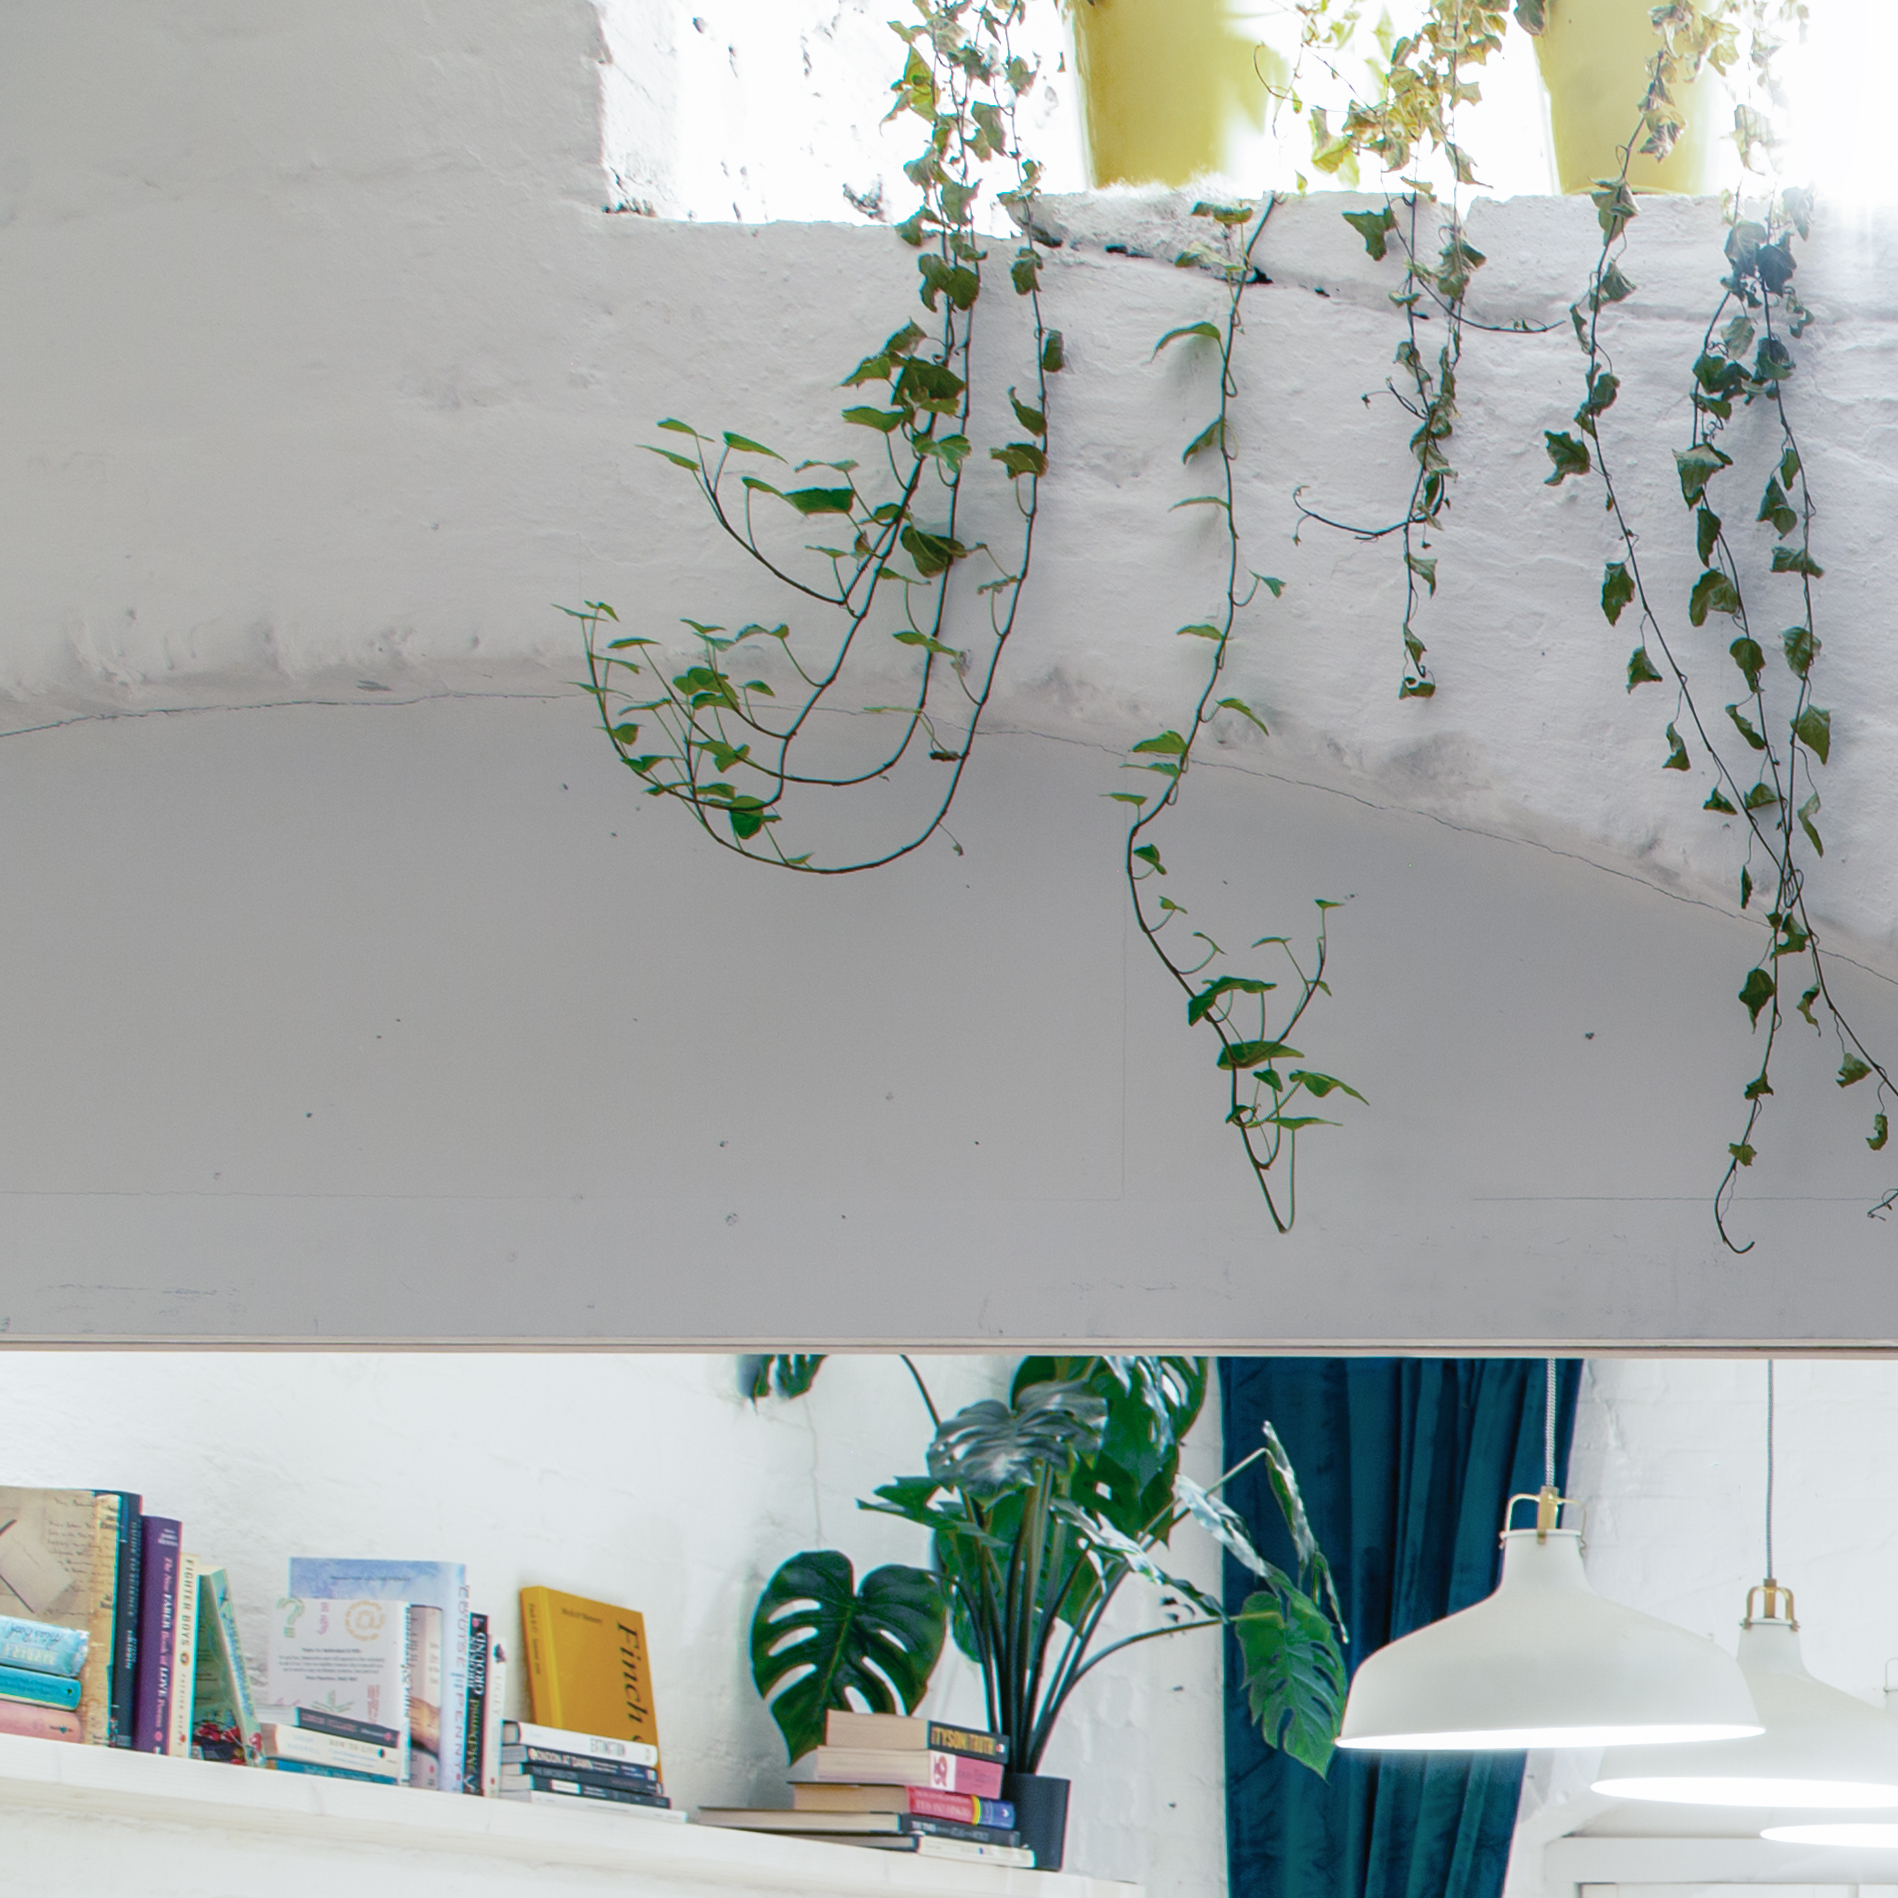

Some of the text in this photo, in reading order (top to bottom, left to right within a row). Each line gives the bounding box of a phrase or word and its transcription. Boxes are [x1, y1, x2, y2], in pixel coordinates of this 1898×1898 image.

[161, 1593, 173, 1629] FABER
[179, 1558, 196, 1647] FIGHTER BOYS
[159, 1631, 170, 1654] Book
[473, 1631, 488, 1695] GROUND
[615, 1620, 650, 1724] Finch
[154, 1698, 166, 1728] Poems
[157, 1667, 169, 1697] LOVE
[453, 1692, 465, 1771] PENNY
[465, 1698, 481, 1762] McDermid
